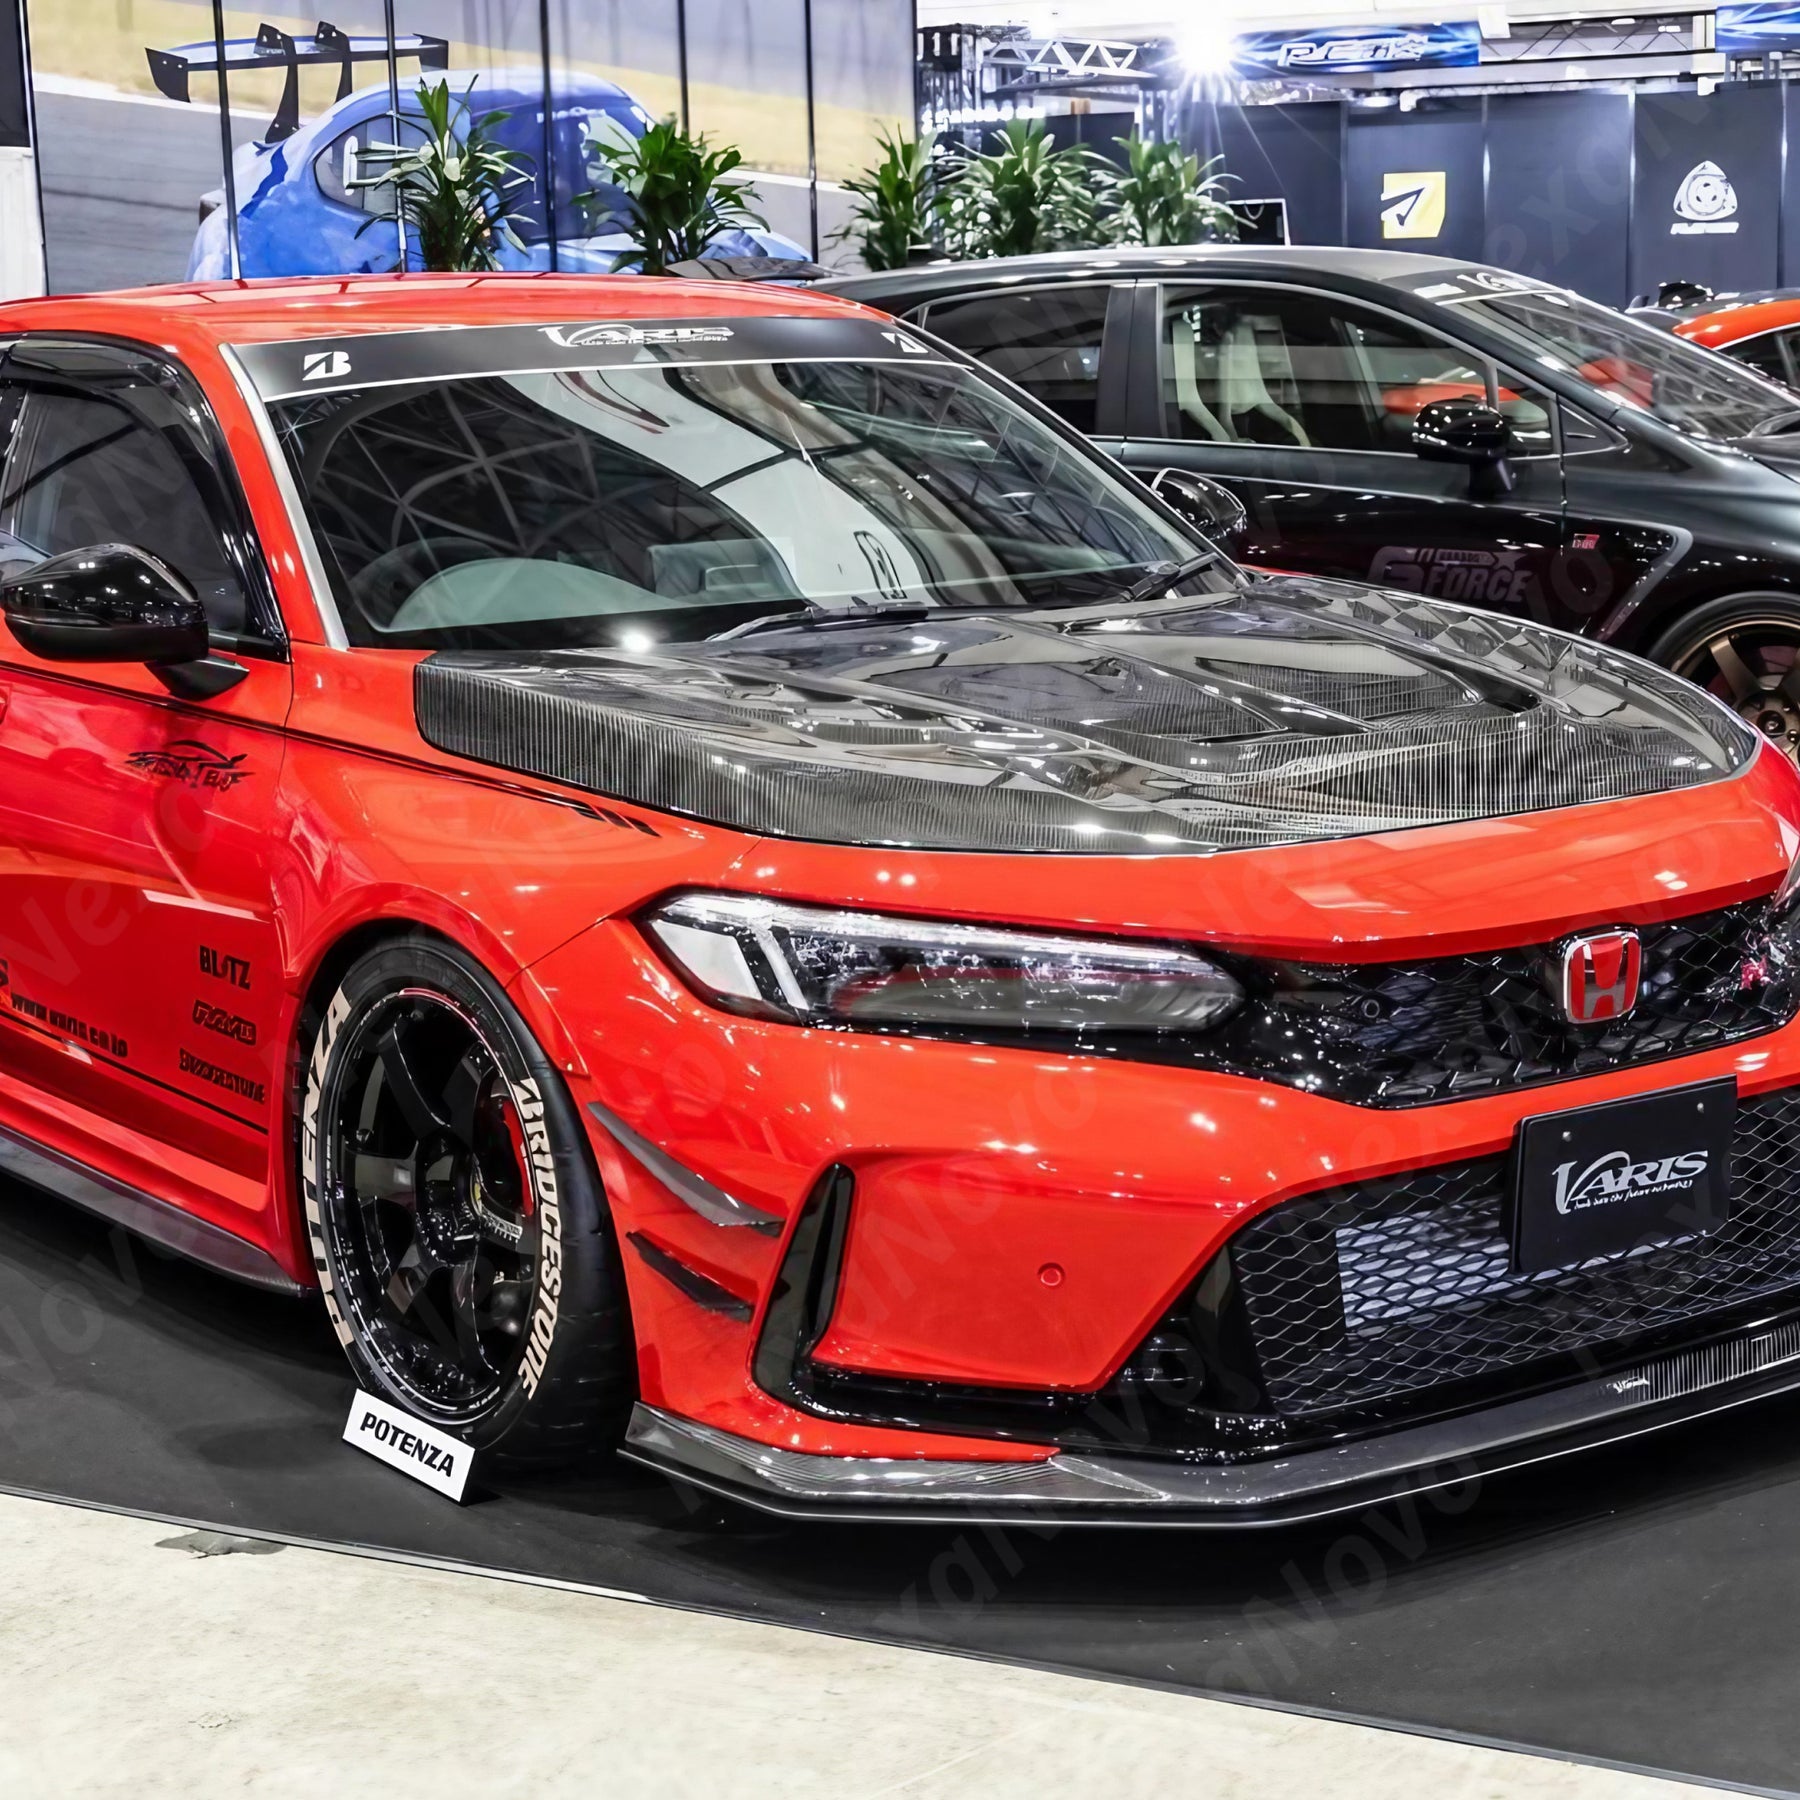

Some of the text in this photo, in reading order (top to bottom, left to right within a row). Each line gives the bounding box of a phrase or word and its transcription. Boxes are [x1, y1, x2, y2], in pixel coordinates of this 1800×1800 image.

[1552, 1150, 1708, 1215] VARIS
[510, 1077, 563, 1400] BRIDGESTONE
[360, 1411, 455, 1478] POTENZA
